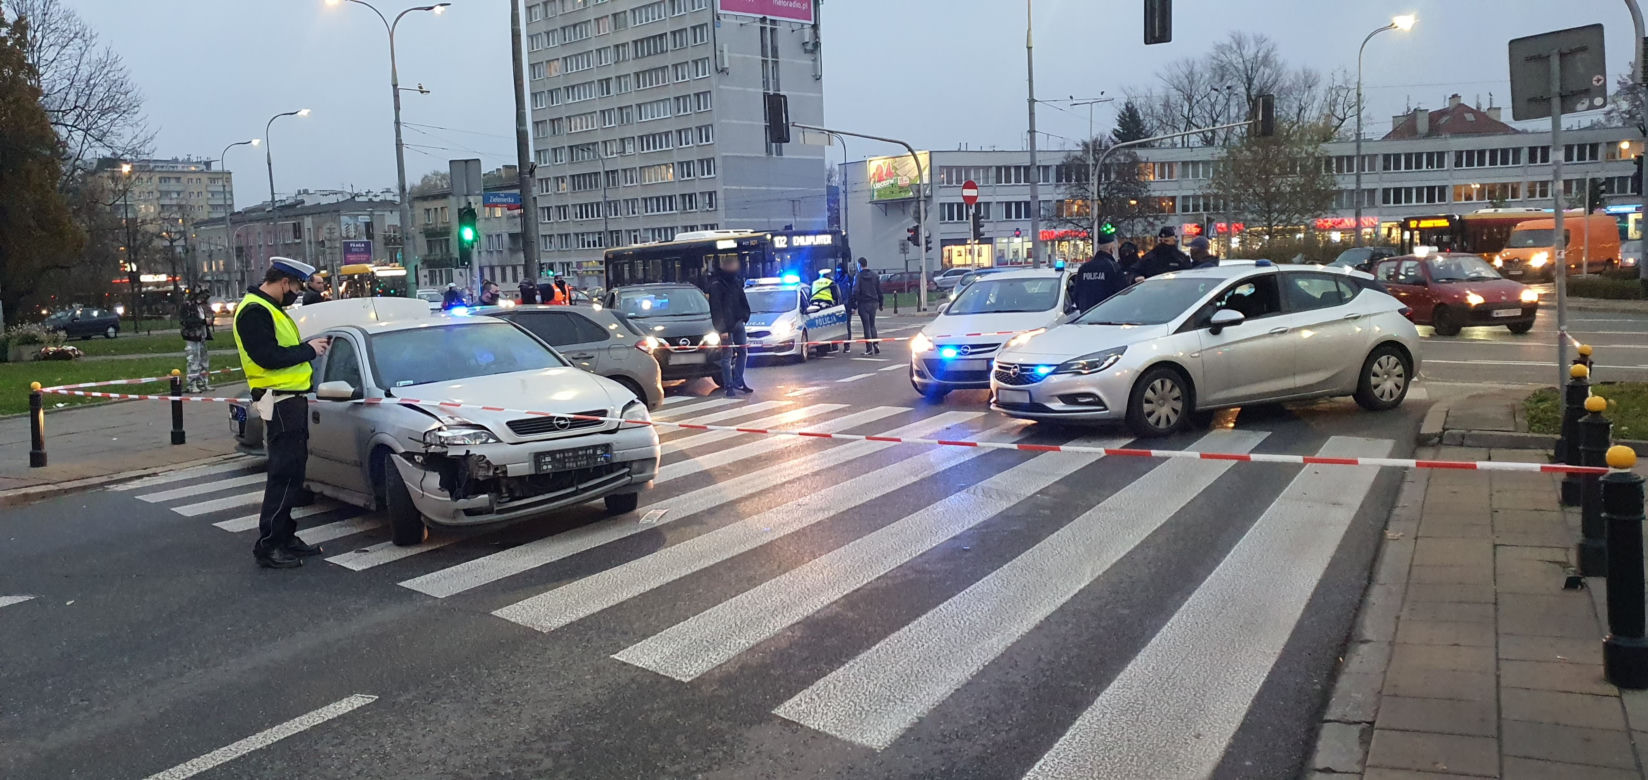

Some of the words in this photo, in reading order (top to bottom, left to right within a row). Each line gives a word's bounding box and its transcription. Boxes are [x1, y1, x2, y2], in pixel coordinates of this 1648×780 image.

[774, 236, 788, 248] 102
[1083, 272, 1105, 281] POLICJA
[815, 315, 837, 326] POLICJA
